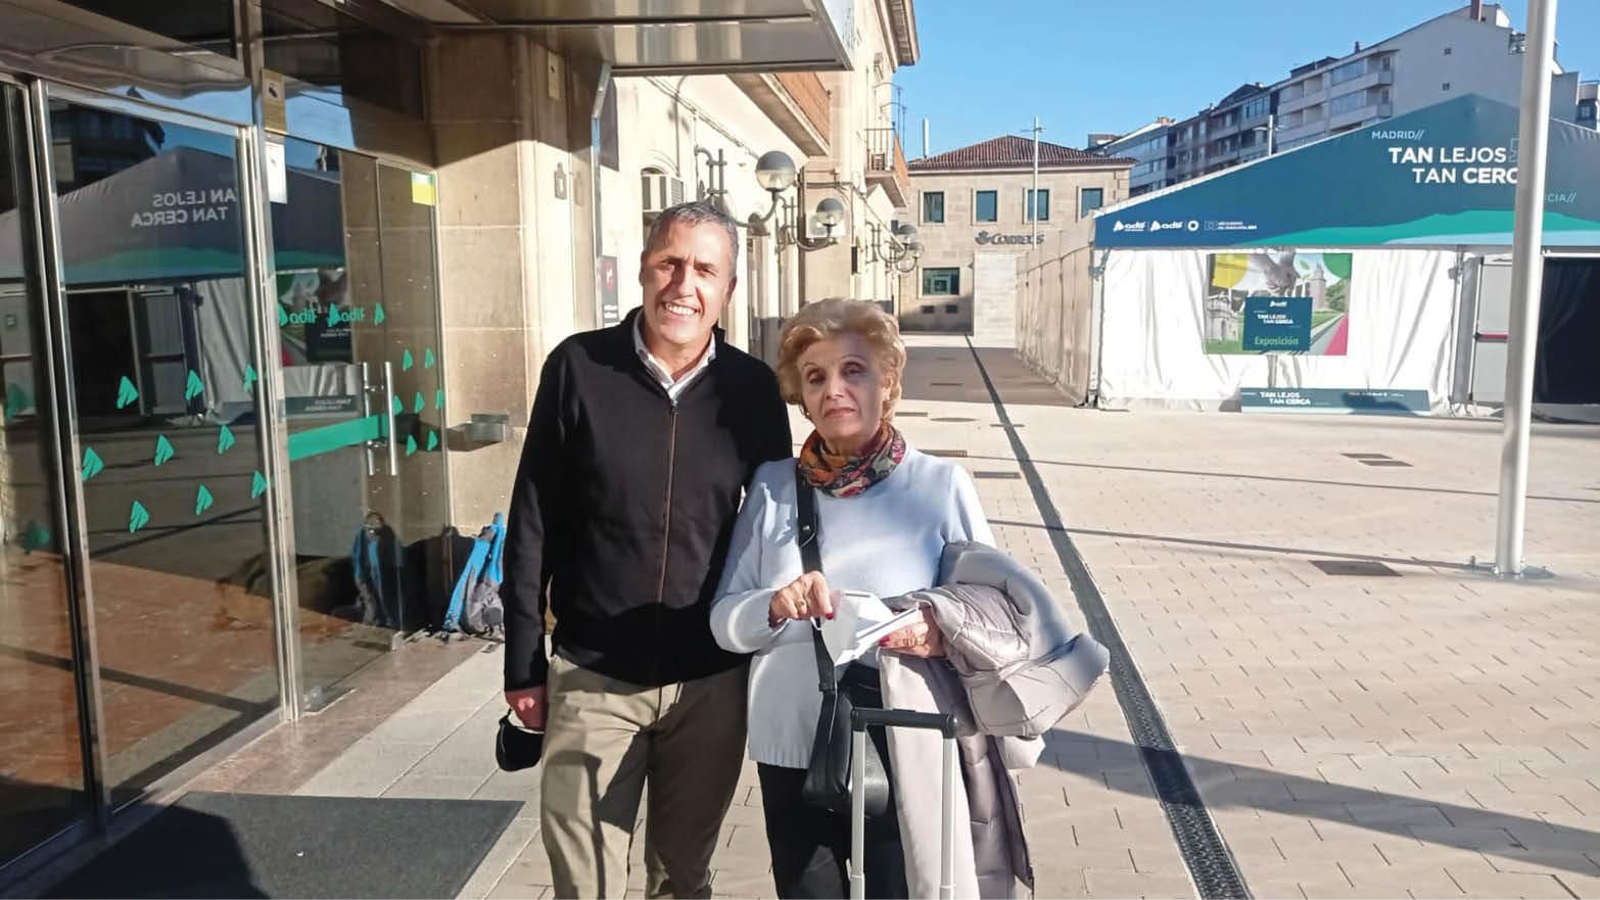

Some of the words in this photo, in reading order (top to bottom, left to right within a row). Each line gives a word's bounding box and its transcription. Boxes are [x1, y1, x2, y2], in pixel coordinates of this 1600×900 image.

[1388, 147, 1433, 163] TAN
[1439, 147, 1507, 163] LEJOS
[1412, 168, 1456, 184] TAN
[1463, 167, 1519, 184] CERC
